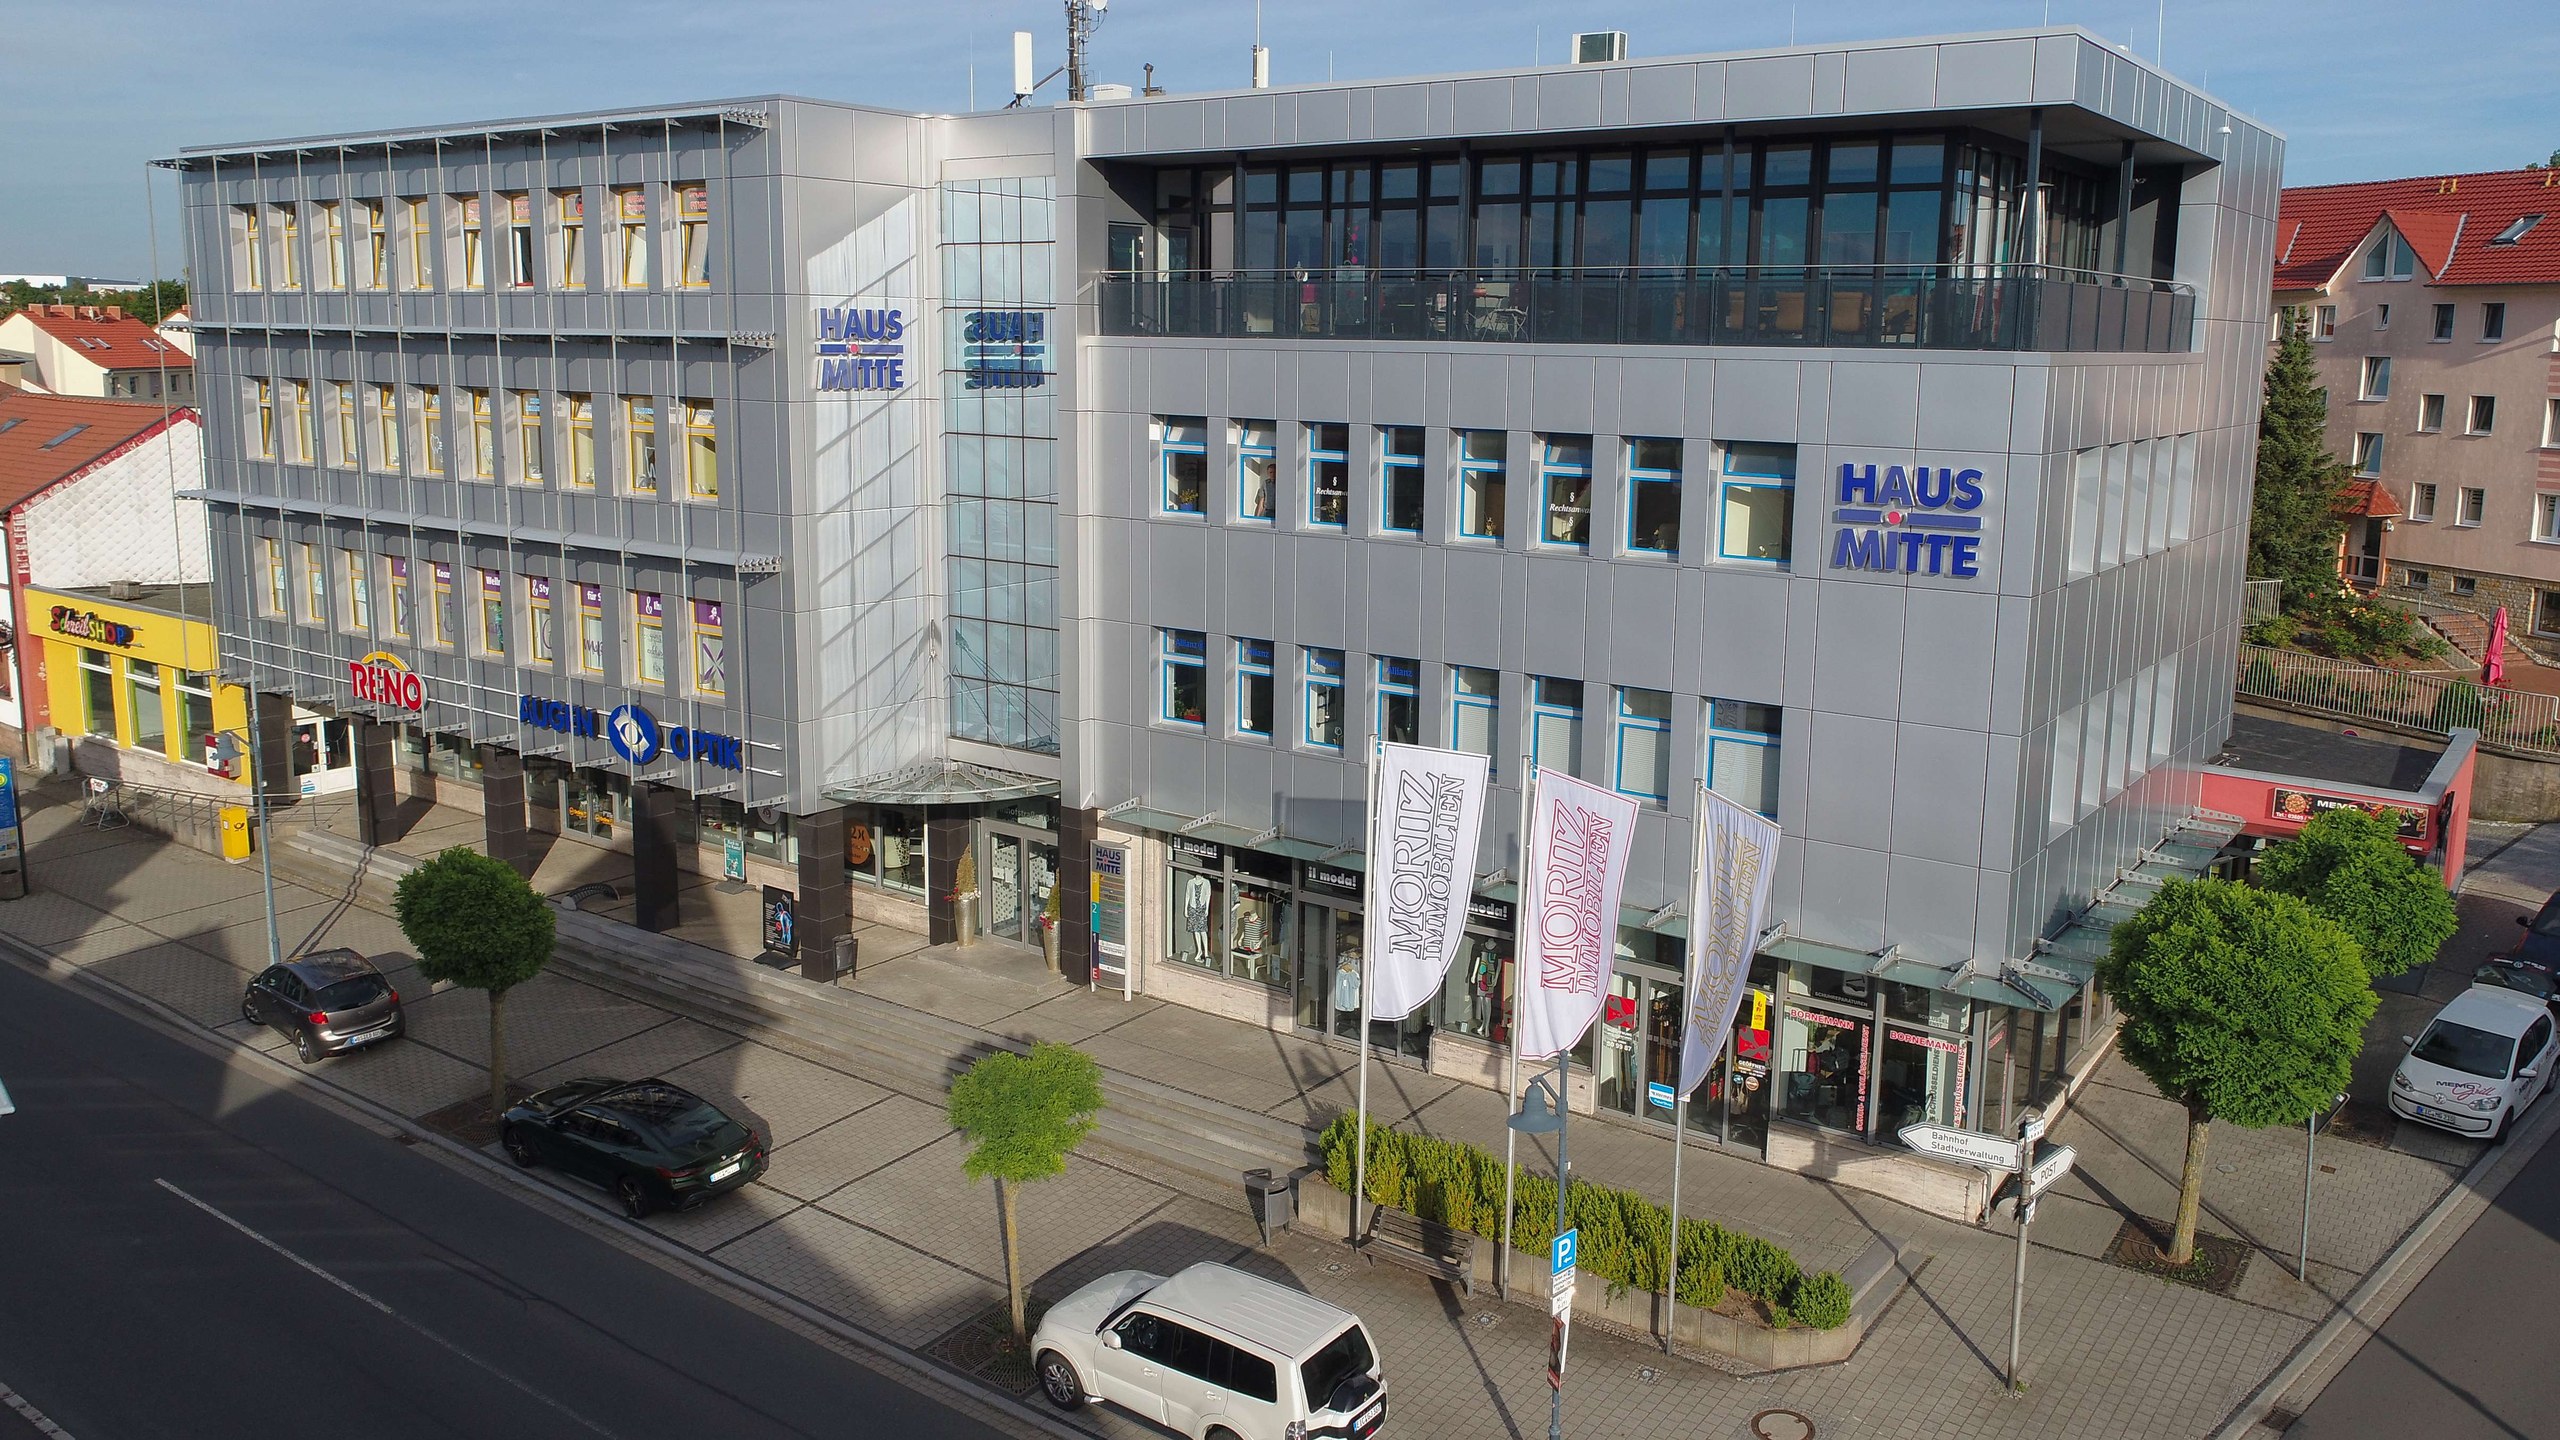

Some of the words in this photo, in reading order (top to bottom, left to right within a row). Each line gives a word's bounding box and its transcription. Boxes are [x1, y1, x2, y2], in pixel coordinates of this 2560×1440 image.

[820, 307, 904, 341] HAUS
[820, 358, 905, 390] MITTE
[1840, 463, 1985, 511] HAUS
[1834, 528, 1982, 577] MITTE
[1386, 665, 1413, 677] Allianz
[349, 661, 423, 712] RENO
[519, 694, 597, 739] AUGEN
[670, 725, 743, 772] OPTIK
[1096, 847, 1121, 861] HAUS
[1183, 840, 1218, 857] moda!
[1095, 862, 1121, 875] MITTE
[1319, 869, 1357, 888] moda!
[1421, 773, 1466, 962] IMMOBILIEN
[1091, 903, 1098, 914] 2
[1575, 811, 1613, 998] IMMOBILIEN
[1092, 967, 1098, 979] E
[1790, 1008, 1855, 1031] BORNEMANN
[1889, 1030, 1958, 1054] BORNEMANN
[2435, 1080, 2476, 1090] MEMO
[1931, 1130, 1969, 1147] Bahnhof
[1930, 1141, 2005, 1164] Stadtverwaltung
[2040, 1161, 2058, 1184] POST
[1557, 1238, 1571, 1268] P
